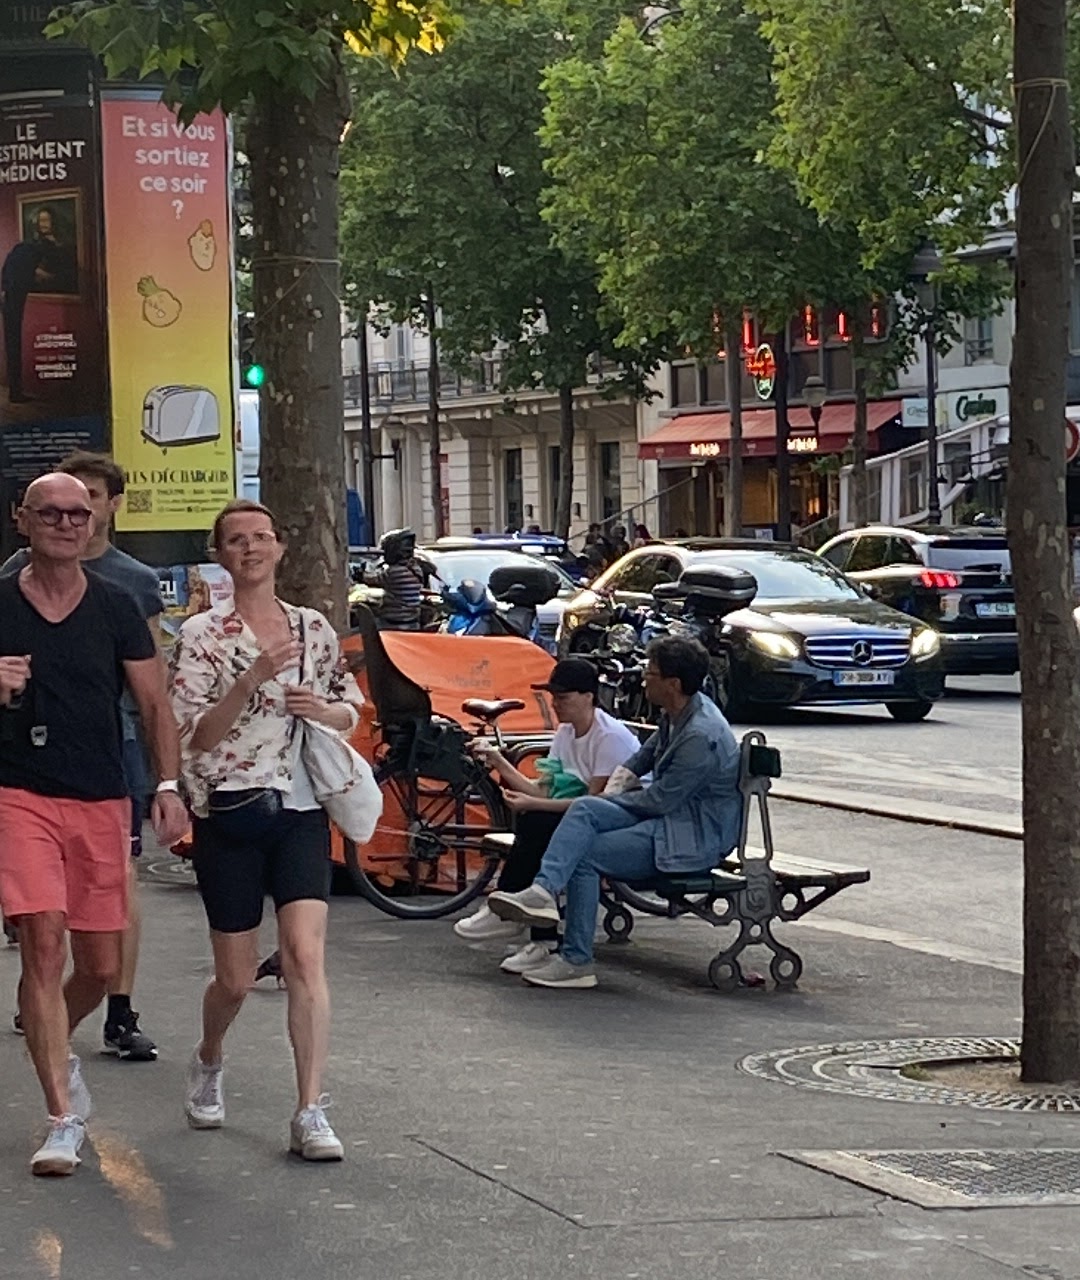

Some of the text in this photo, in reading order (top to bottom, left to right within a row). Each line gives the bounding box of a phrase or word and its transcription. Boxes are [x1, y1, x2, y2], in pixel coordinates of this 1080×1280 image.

[16, 123, 37, 141] LE
[122, 115, 216, 142] Et si vous
[135, 145, 210, 168] sortiez
[140, 172, 207, 194] ce soir
[171, 199, 184, 220] ?
